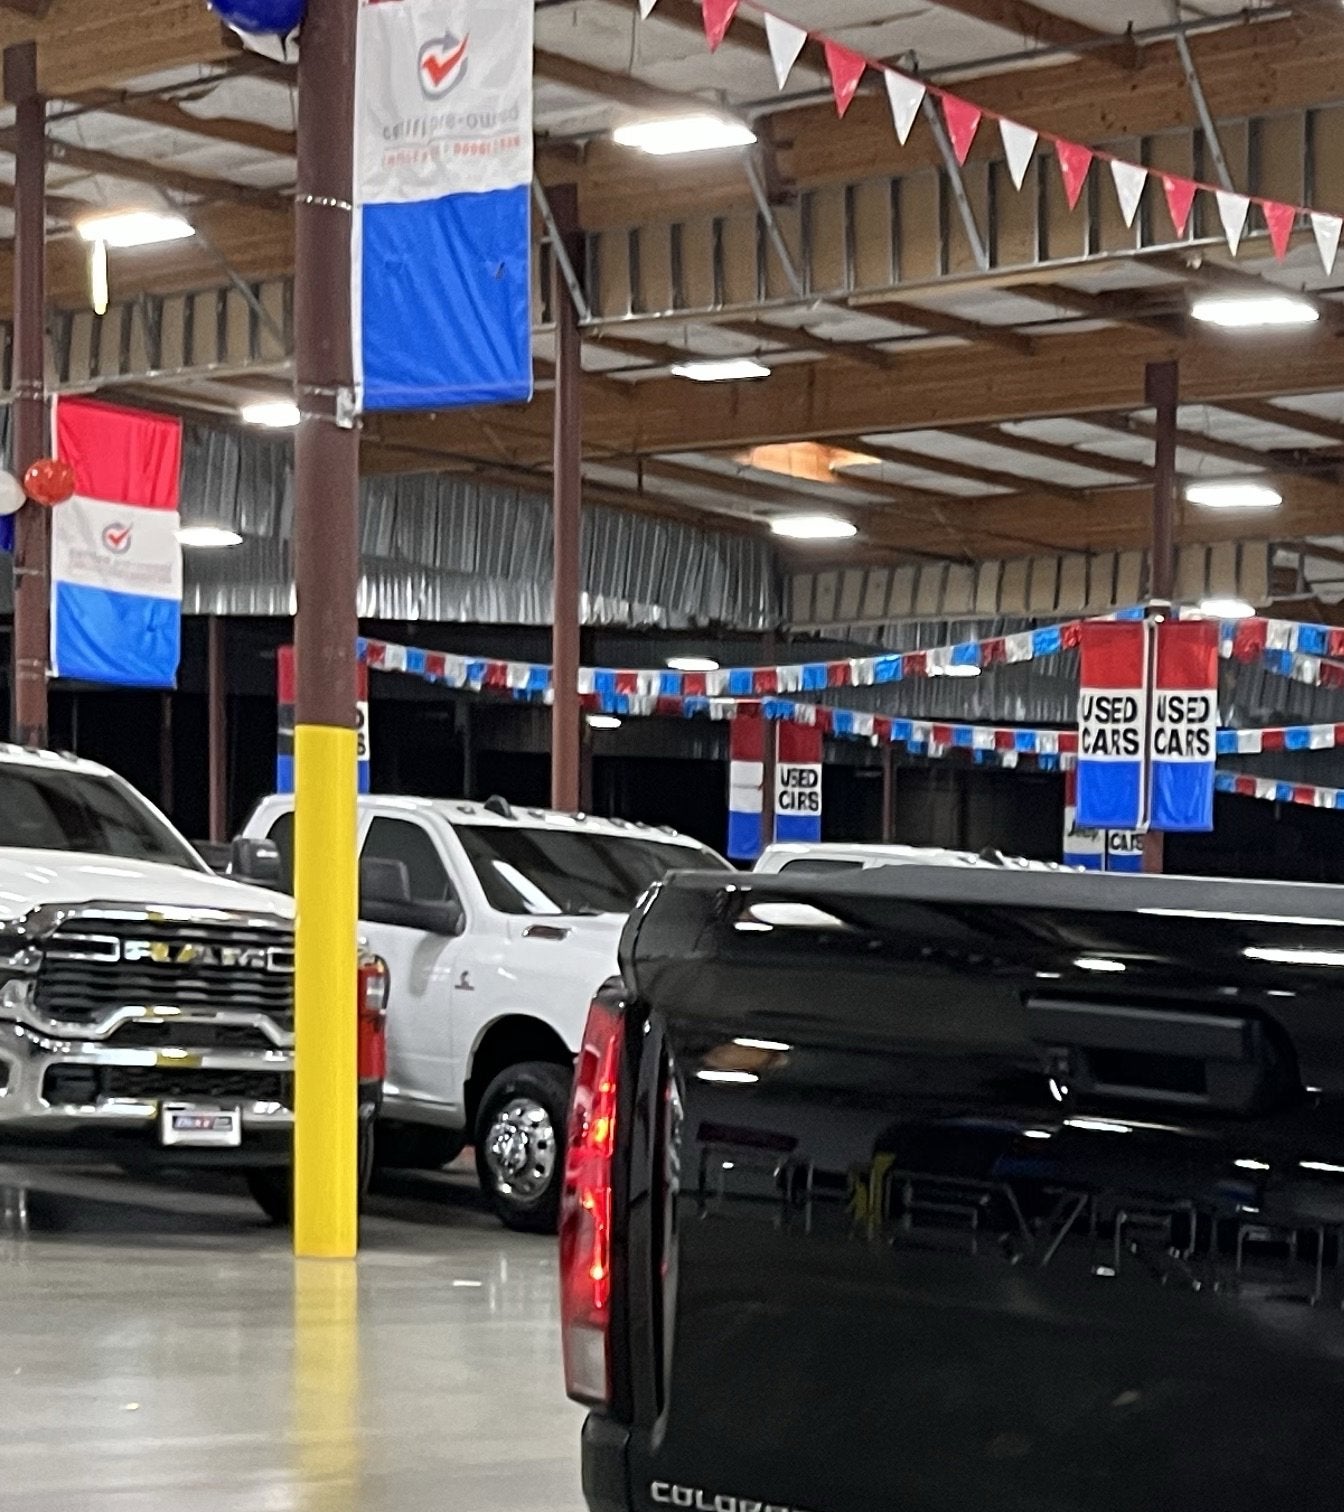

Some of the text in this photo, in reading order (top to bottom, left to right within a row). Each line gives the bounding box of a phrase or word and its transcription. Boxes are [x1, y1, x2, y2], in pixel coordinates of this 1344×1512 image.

[1082, 694, 1138, 724] USED
[1156, 694, 1210, 724] USED
[1081, 727, 1140, 756] CARS
[1154, 727, 1210, 757] CARS
[780, 765, 819, 788] USED
